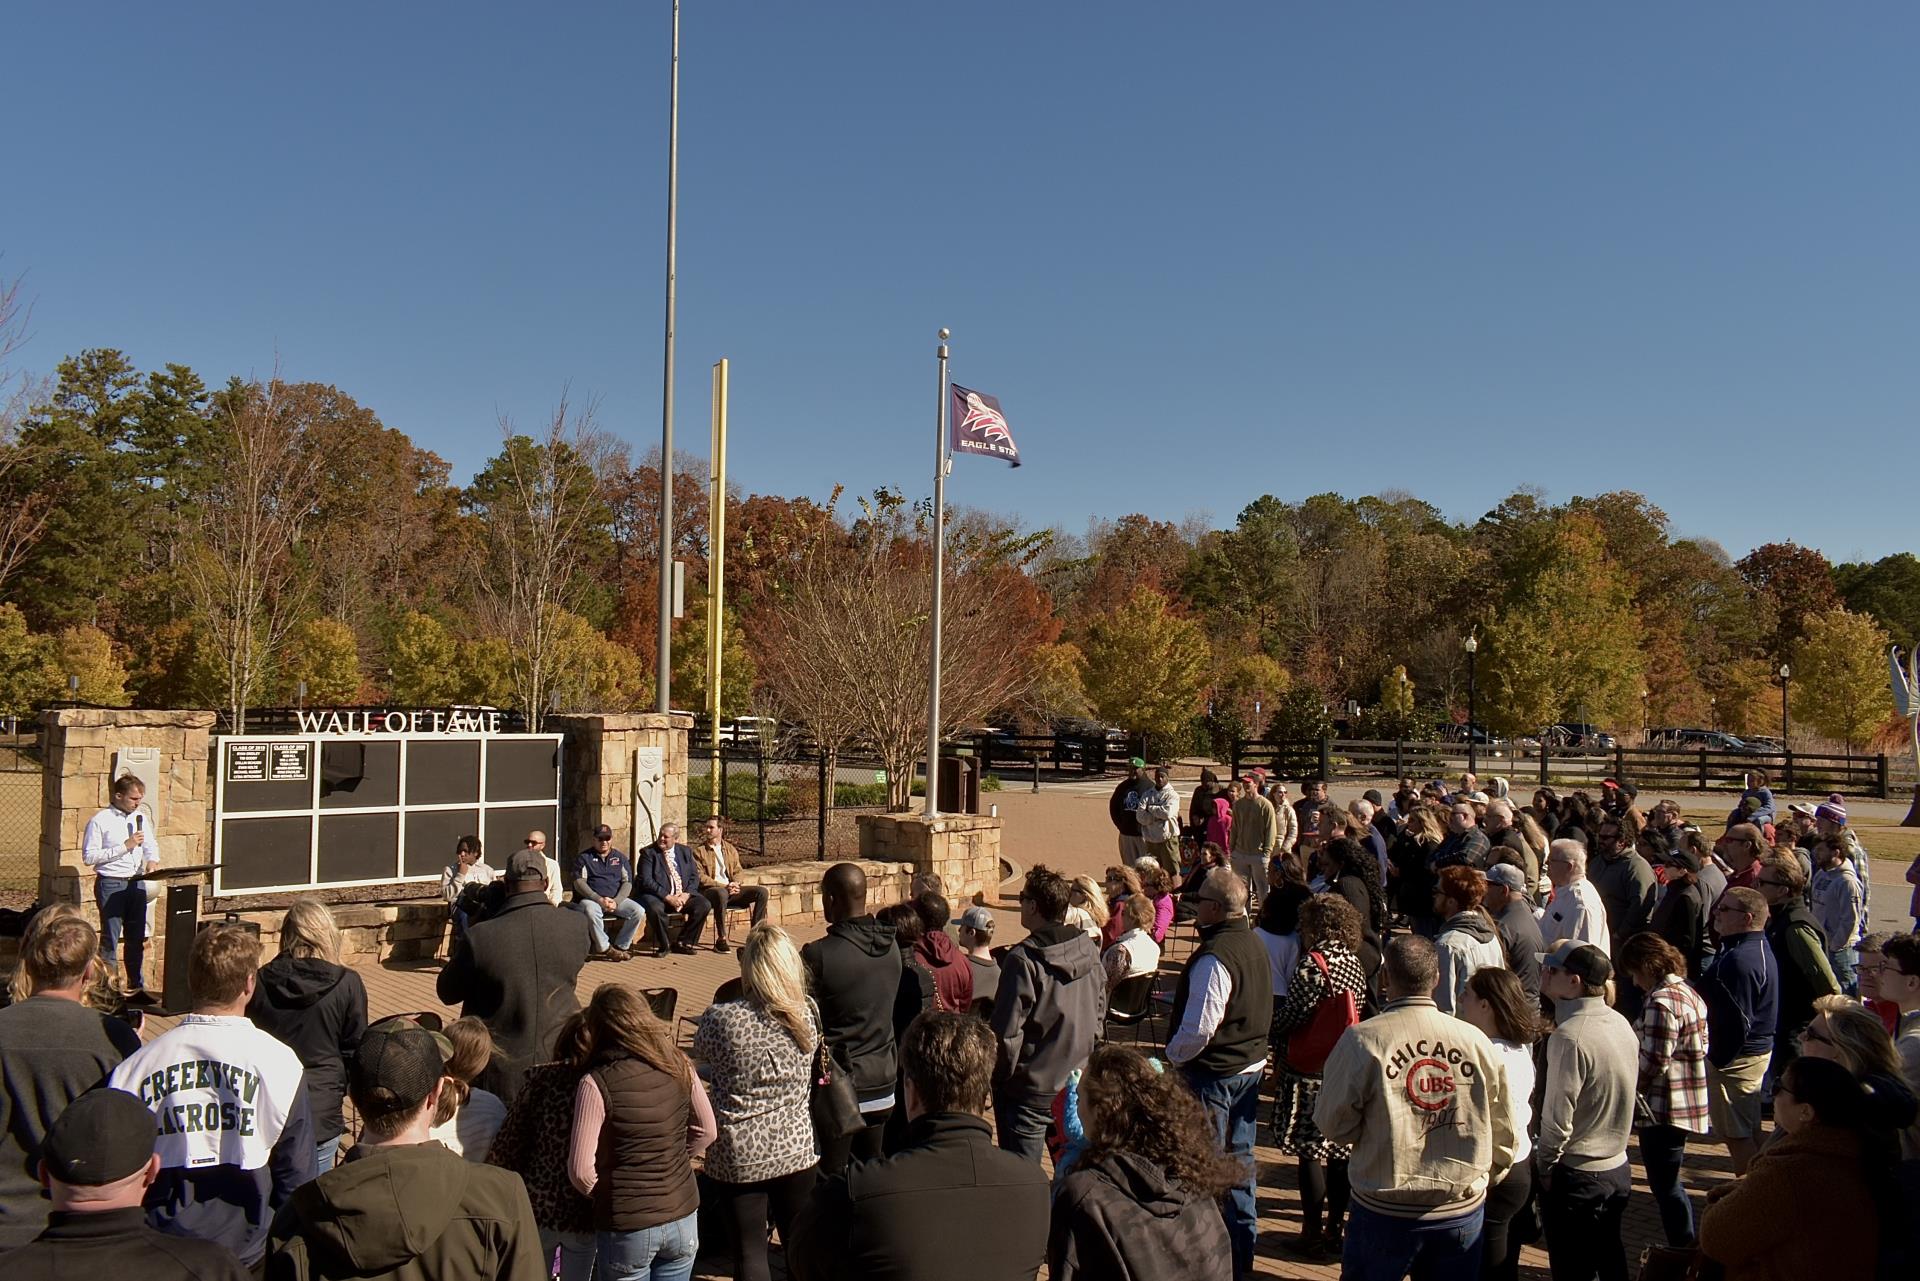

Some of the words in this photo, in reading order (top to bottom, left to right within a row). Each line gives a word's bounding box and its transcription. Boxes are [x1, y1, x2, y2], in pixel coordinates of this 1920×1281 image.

[961, 440, 996, 451] EAGLE
[296, 711, 376, 733] WALL
[384, 711, 423, 733] OF
[431, 711, 501, 734] FAME
[1386, 1040, 1475, 1079] CHICAGO
[140, 1060, 260, 1107] CREEKVIEW
[1406, 1058, 1456, 1111] CUBS
[157, 1102, 255, 1136] ACROSE
